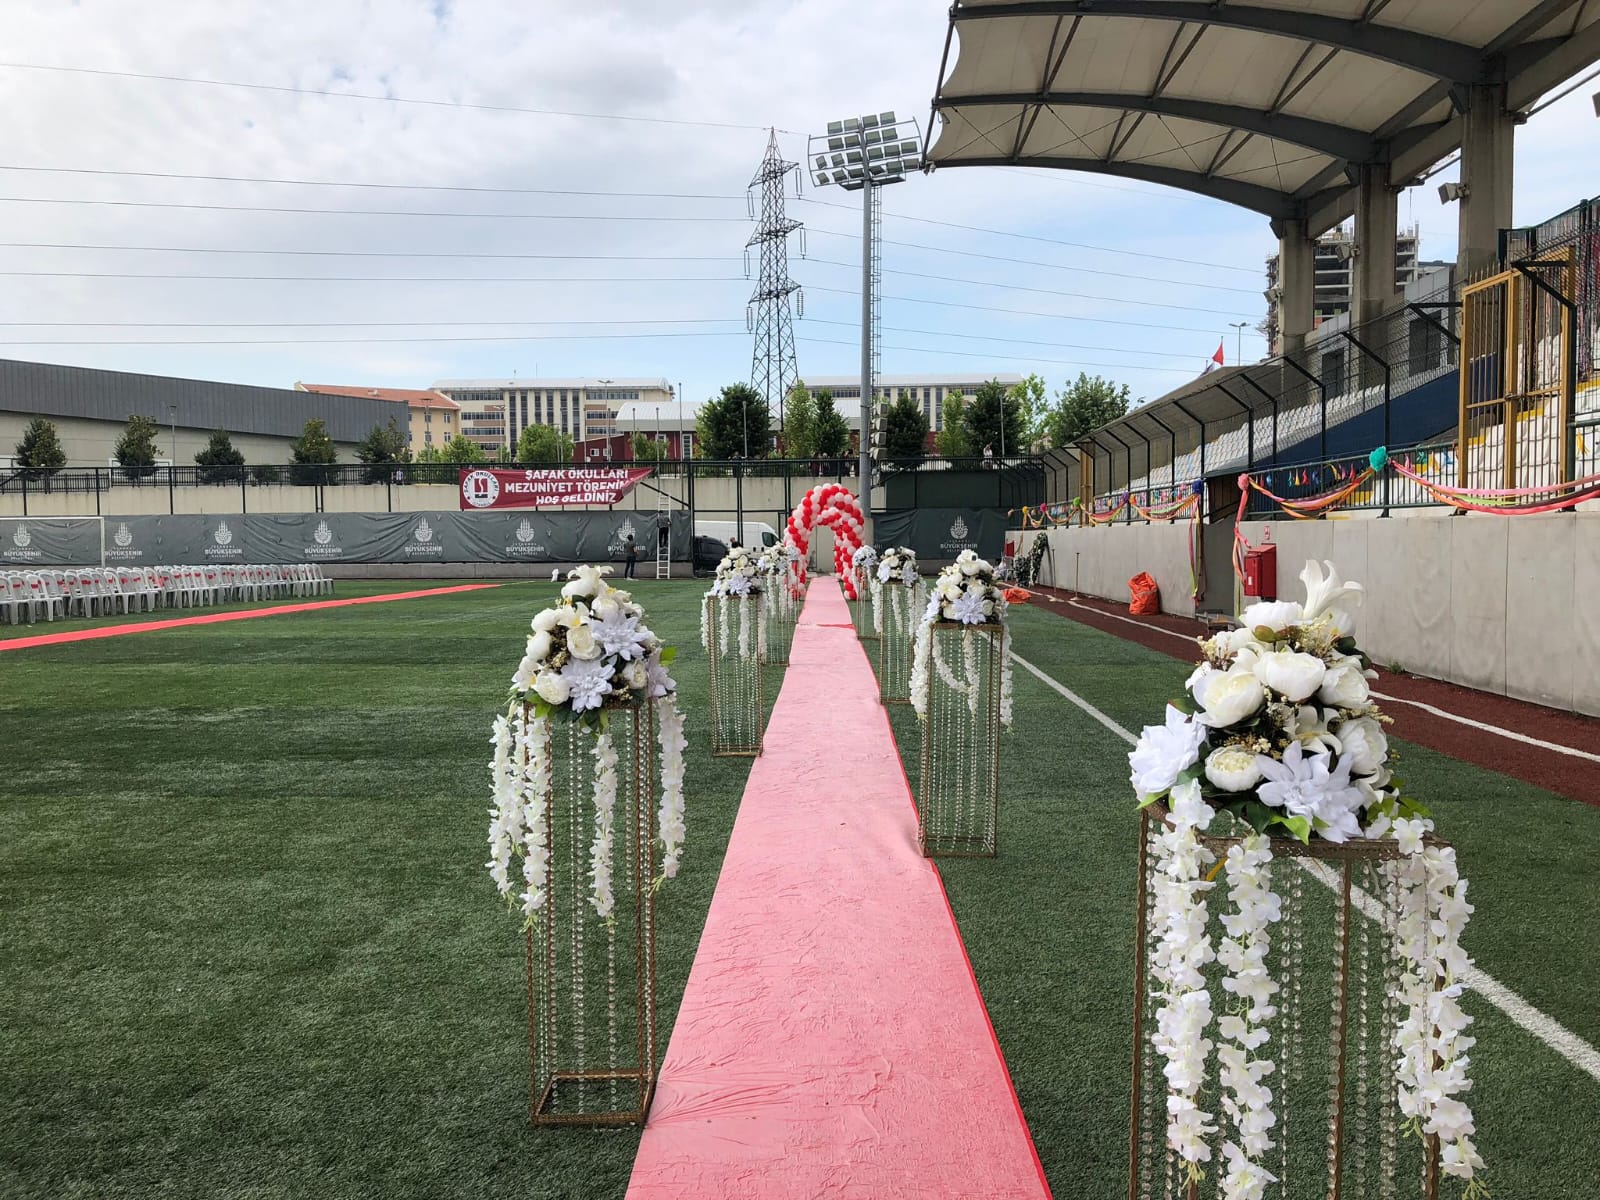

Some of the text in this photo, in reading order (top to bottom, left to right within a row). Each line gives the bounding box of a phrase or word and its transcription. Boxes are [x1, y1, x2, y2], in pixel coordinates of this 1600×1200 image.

[525, 470, 628, 480] ŞAFAK OKULLARI
[505, 480, 572, 493] MEZUNİYET
[536, 490, 617, 504] HOŞ GELDİNİZ
